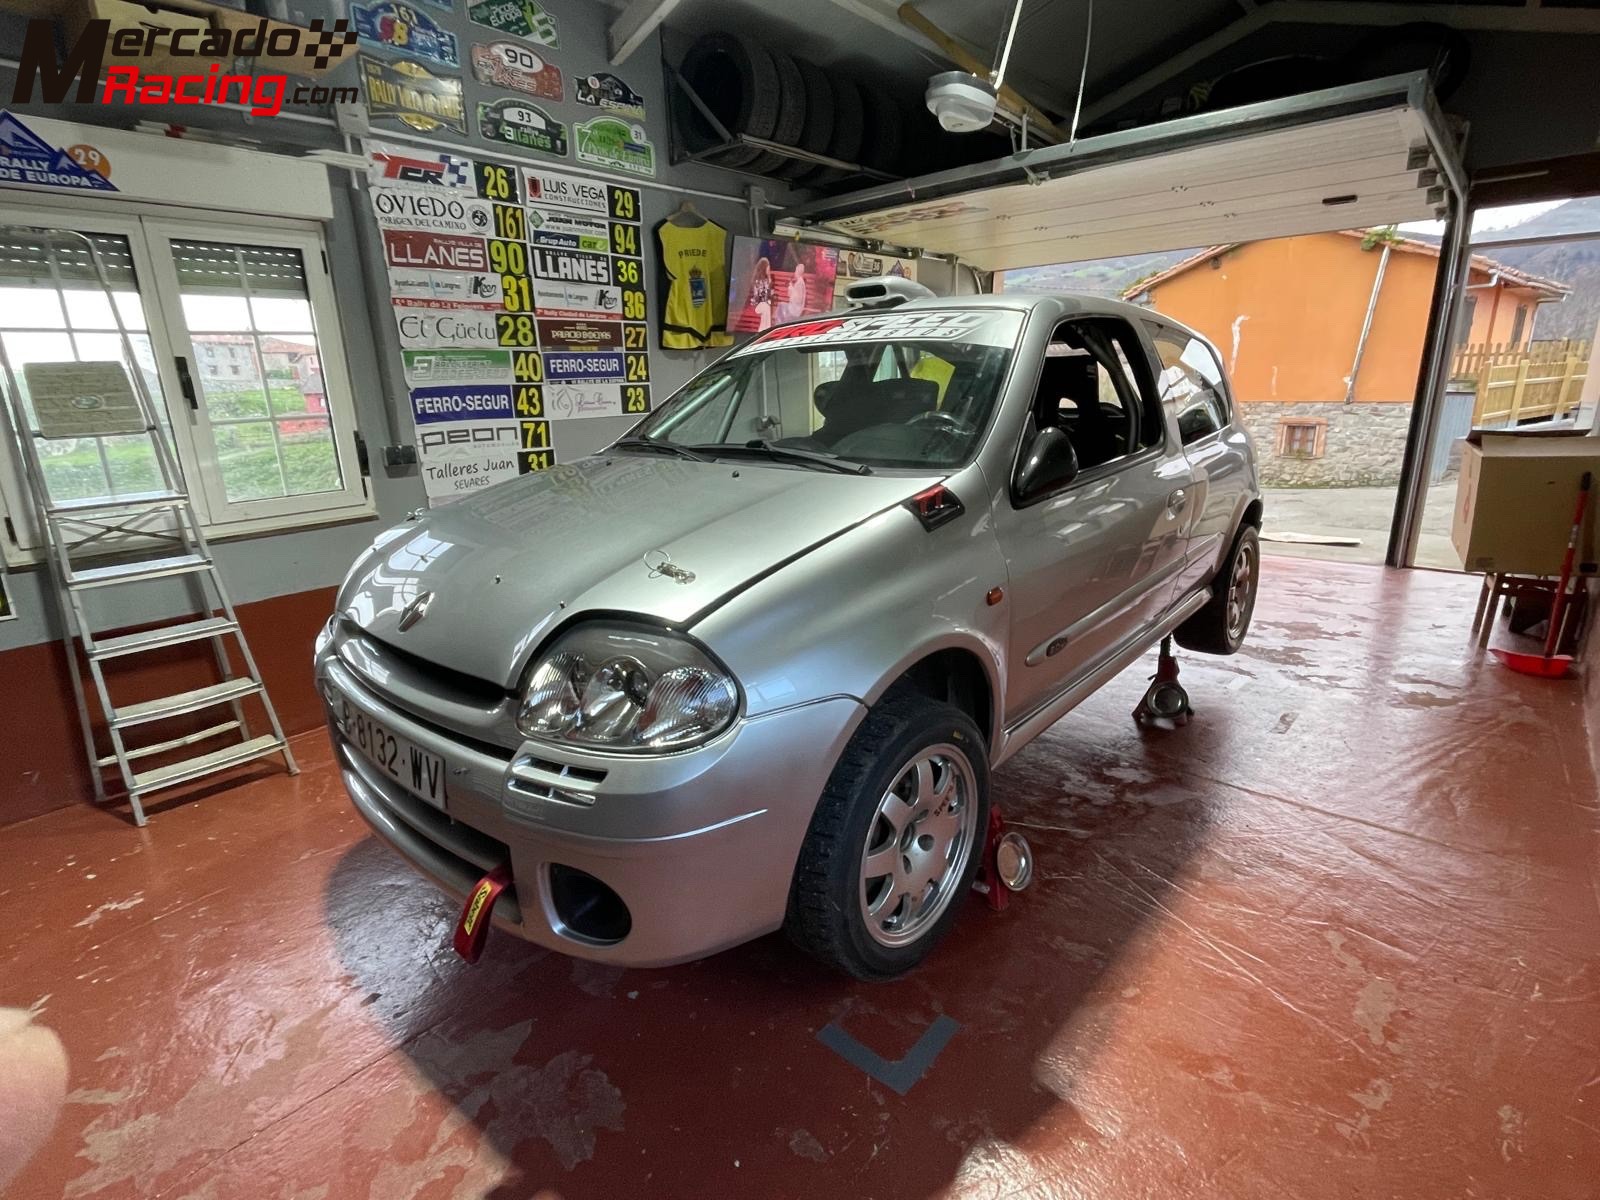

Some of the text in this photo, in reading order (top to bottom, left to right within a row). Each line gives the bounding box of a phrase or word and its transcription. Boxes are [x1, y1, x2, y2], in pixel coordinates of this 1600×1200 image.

[504, 48, 533, 69] 90
[577, 90, 595, 104] LA
[517, 110, 531, 123] 93
[0, 155, 50, 171] RALLY
[75, 148, 101, 167] 29
[0, 169, 92, 187] DE EUROPA
[484, 165, 509, 199] 26
[543, 178, 606, 201] LUIS VEGA
[376, 193, 464, 220] OVIEDO
[544, 193, 606, 209] CONSTRUCCIONES
[615, 189, 634, 219] 29
[380, 216, 467, 231] ORIGEN DEL CAMINO
[496, 206, 524, 240] 161
[559, 238, 577, 247] Auto
[615, 224, 636, 255] 94
[391, 243, 485, 268] LLANES
[490, 240, 525, 275] 90
[678, 248, 707, 259] PRIEDE
[533, 249, 609, 283] LLANES
[617, 260, 639, 284] 36
[503, 275, 532, 312] 31
[624, 290, 646, 320] 36
[400, 316, 428, 339] El
[498, 315, 534, 346] 28
[625, 326, 646, 348] 27
[515, 352, 542, 382] 40
[549, 358, 620, 374] FERRO-SEGUR
[627, 355, 647, 381] 24
[415, 394, 510, 415] FERRO-SEGUR
[516, 387, 541, 416] 43
[626, 387, 646, 412] 23
[421, 427, 518, 455] peon
[522, 422, 547, 449] 71
[426, 458, 515, 480] Talleres Juan
[528, 453, 549, 472] 31
[454, 476, 491, 490] SEVARES
